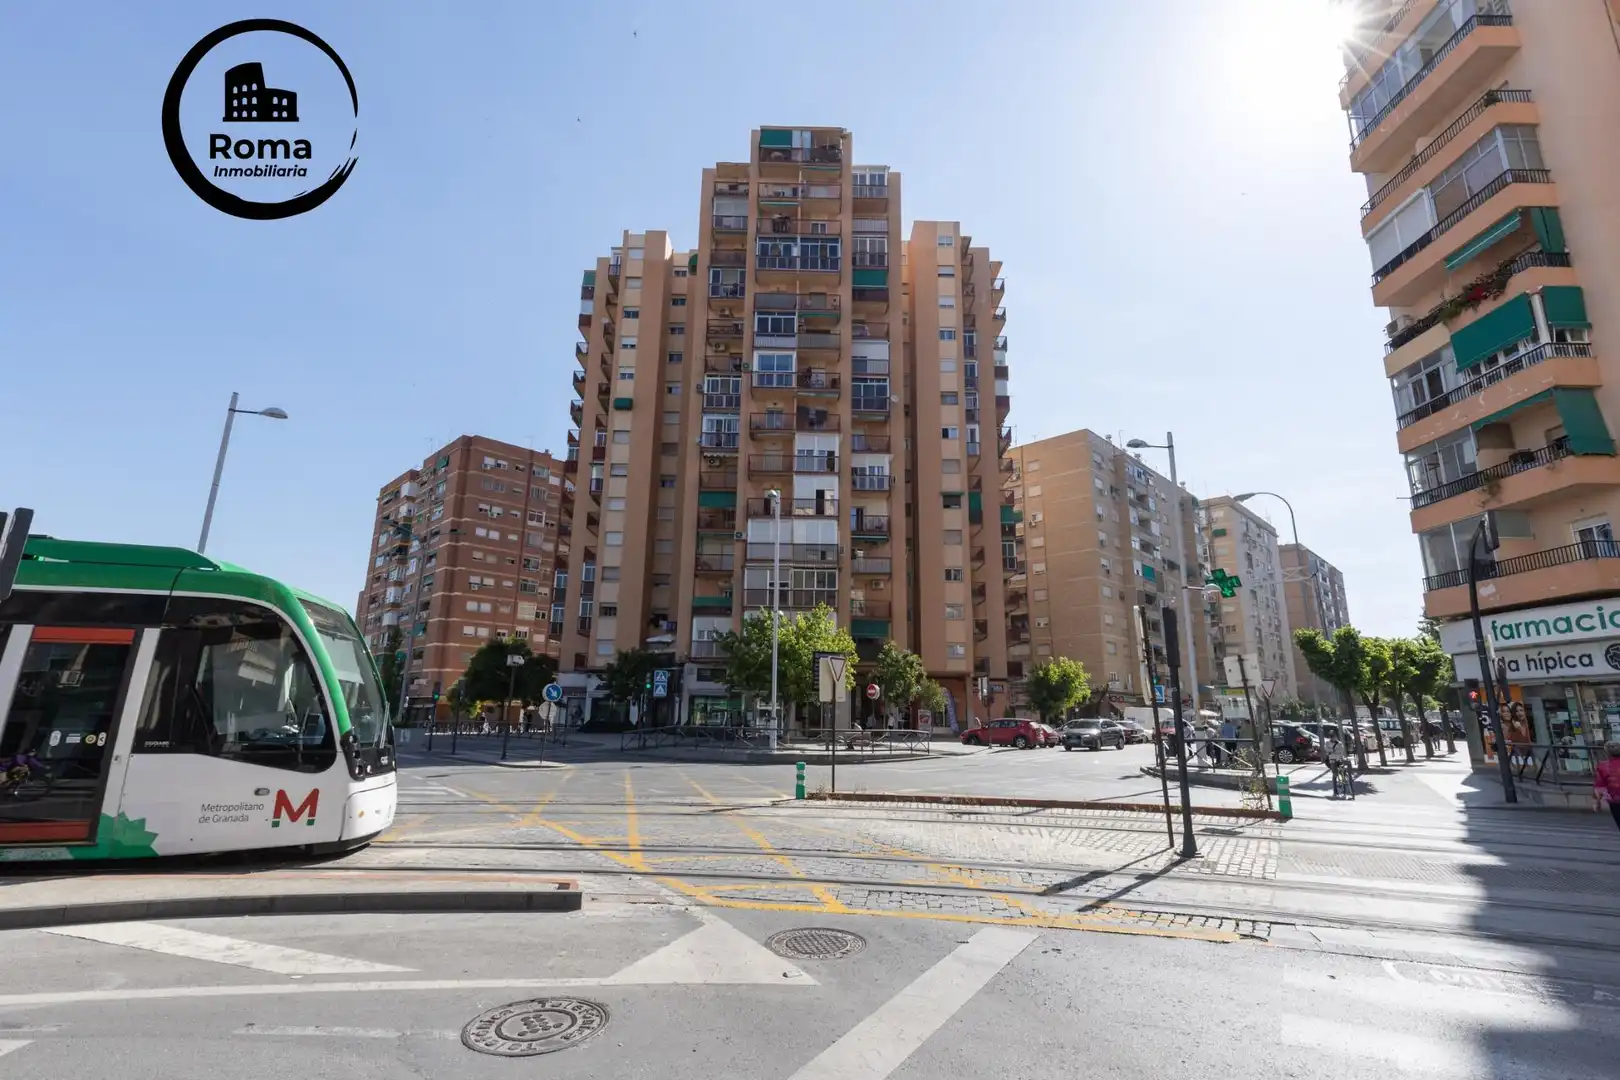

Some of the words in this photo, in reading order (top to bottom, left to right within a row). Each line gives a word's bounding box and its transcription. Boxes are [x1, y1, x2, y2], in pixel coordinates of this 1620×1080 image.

[1525, 651, 1594, 674] hípica
[200, 801, 265, 814] Metropolitano
[198, 815, 211, 824] de
[212, 813, 250, 824] Granada
